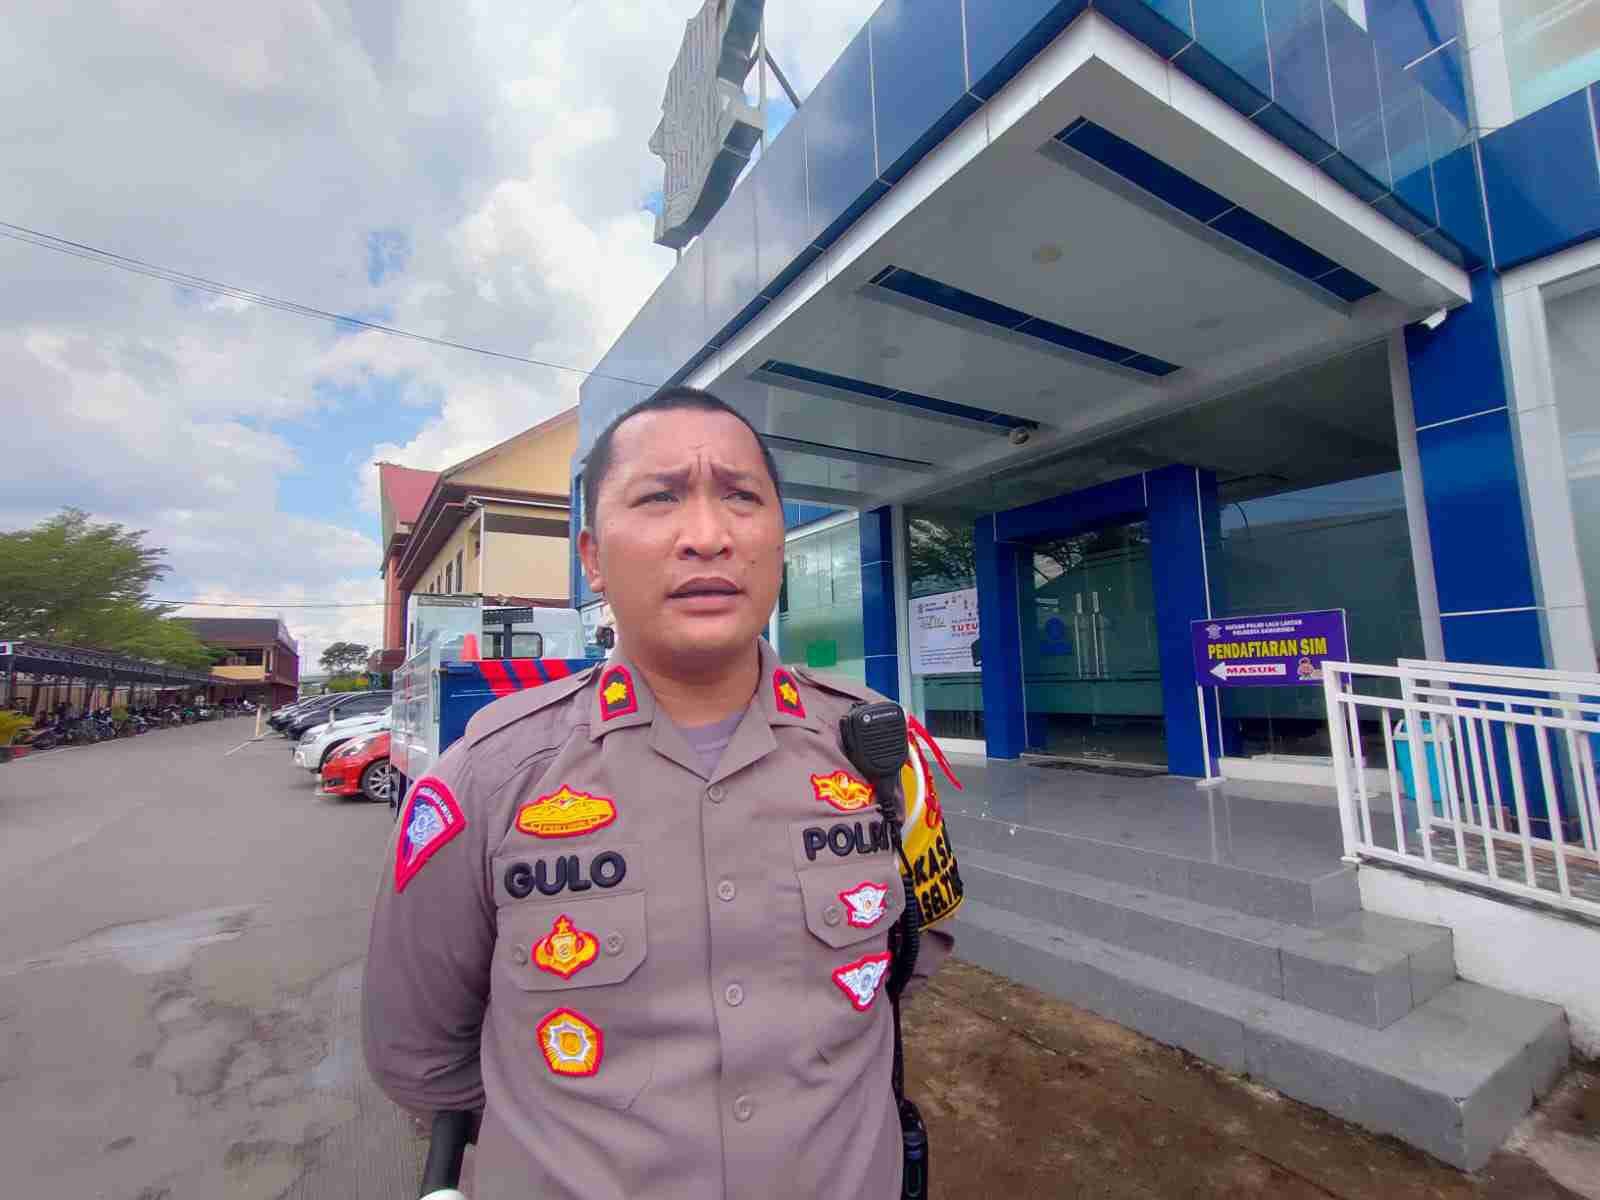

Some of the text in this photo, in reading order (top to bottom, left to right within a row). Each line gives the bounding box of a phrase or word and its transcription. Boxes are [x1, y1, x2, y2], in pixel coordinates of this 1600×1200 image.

[1208, 637, 1328, 660] PENDAFTARAN SIM
[1226, 666, 1277, 675] MASUK
[504, 850, 627, 899] GULO
